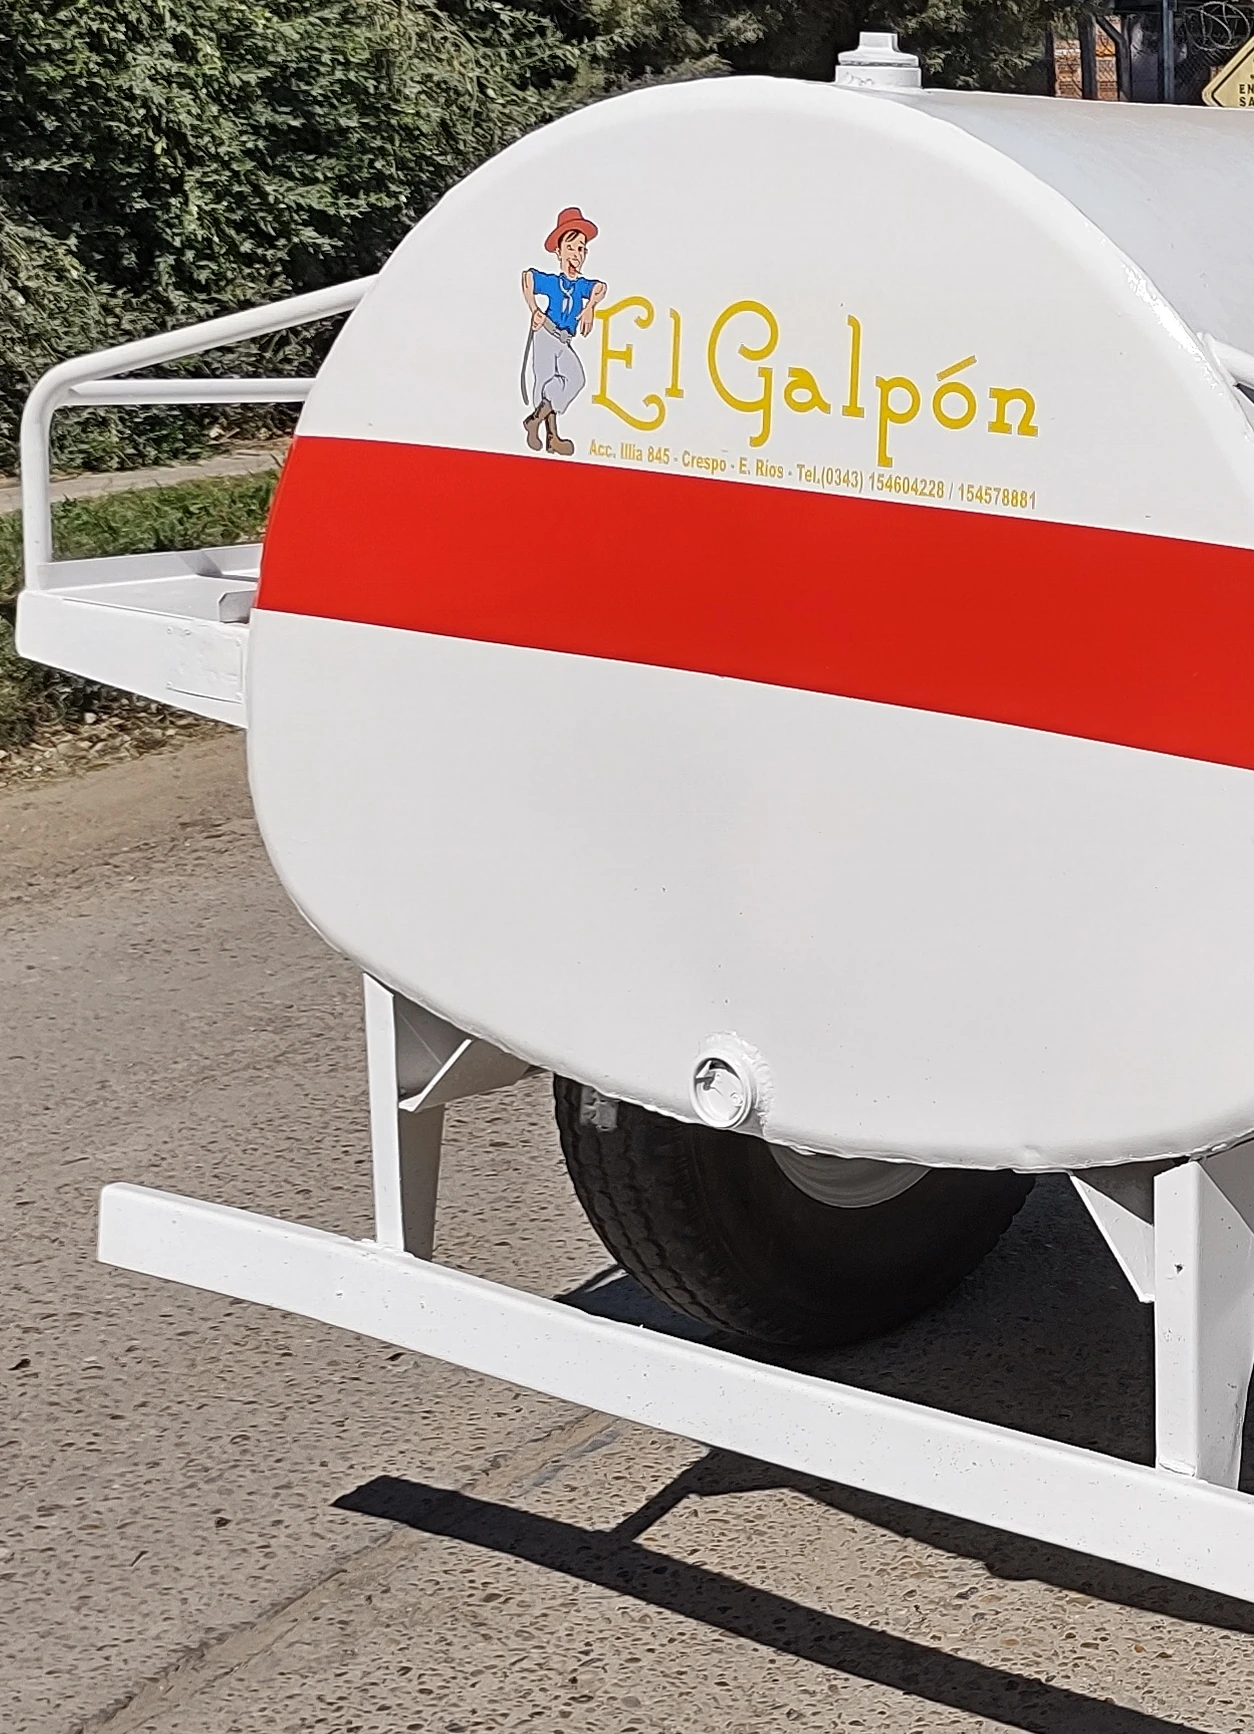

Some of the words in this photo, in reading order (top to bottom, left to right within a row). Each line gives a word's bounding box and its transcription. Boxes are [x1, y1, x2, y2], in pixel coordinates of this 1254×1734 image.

[591, 295, 684, 432] El
[706, 299, 1039, 468] Galpón
[589, 439, 616, 459] Acc.
[647, 446, 670, 465] 845
[682, 450, 726, 475] Crespo
[738, 457, 751, 475] E.
[869, 471, 945, 499] 154604228
[958, 482, 1036, 510] 154578881
